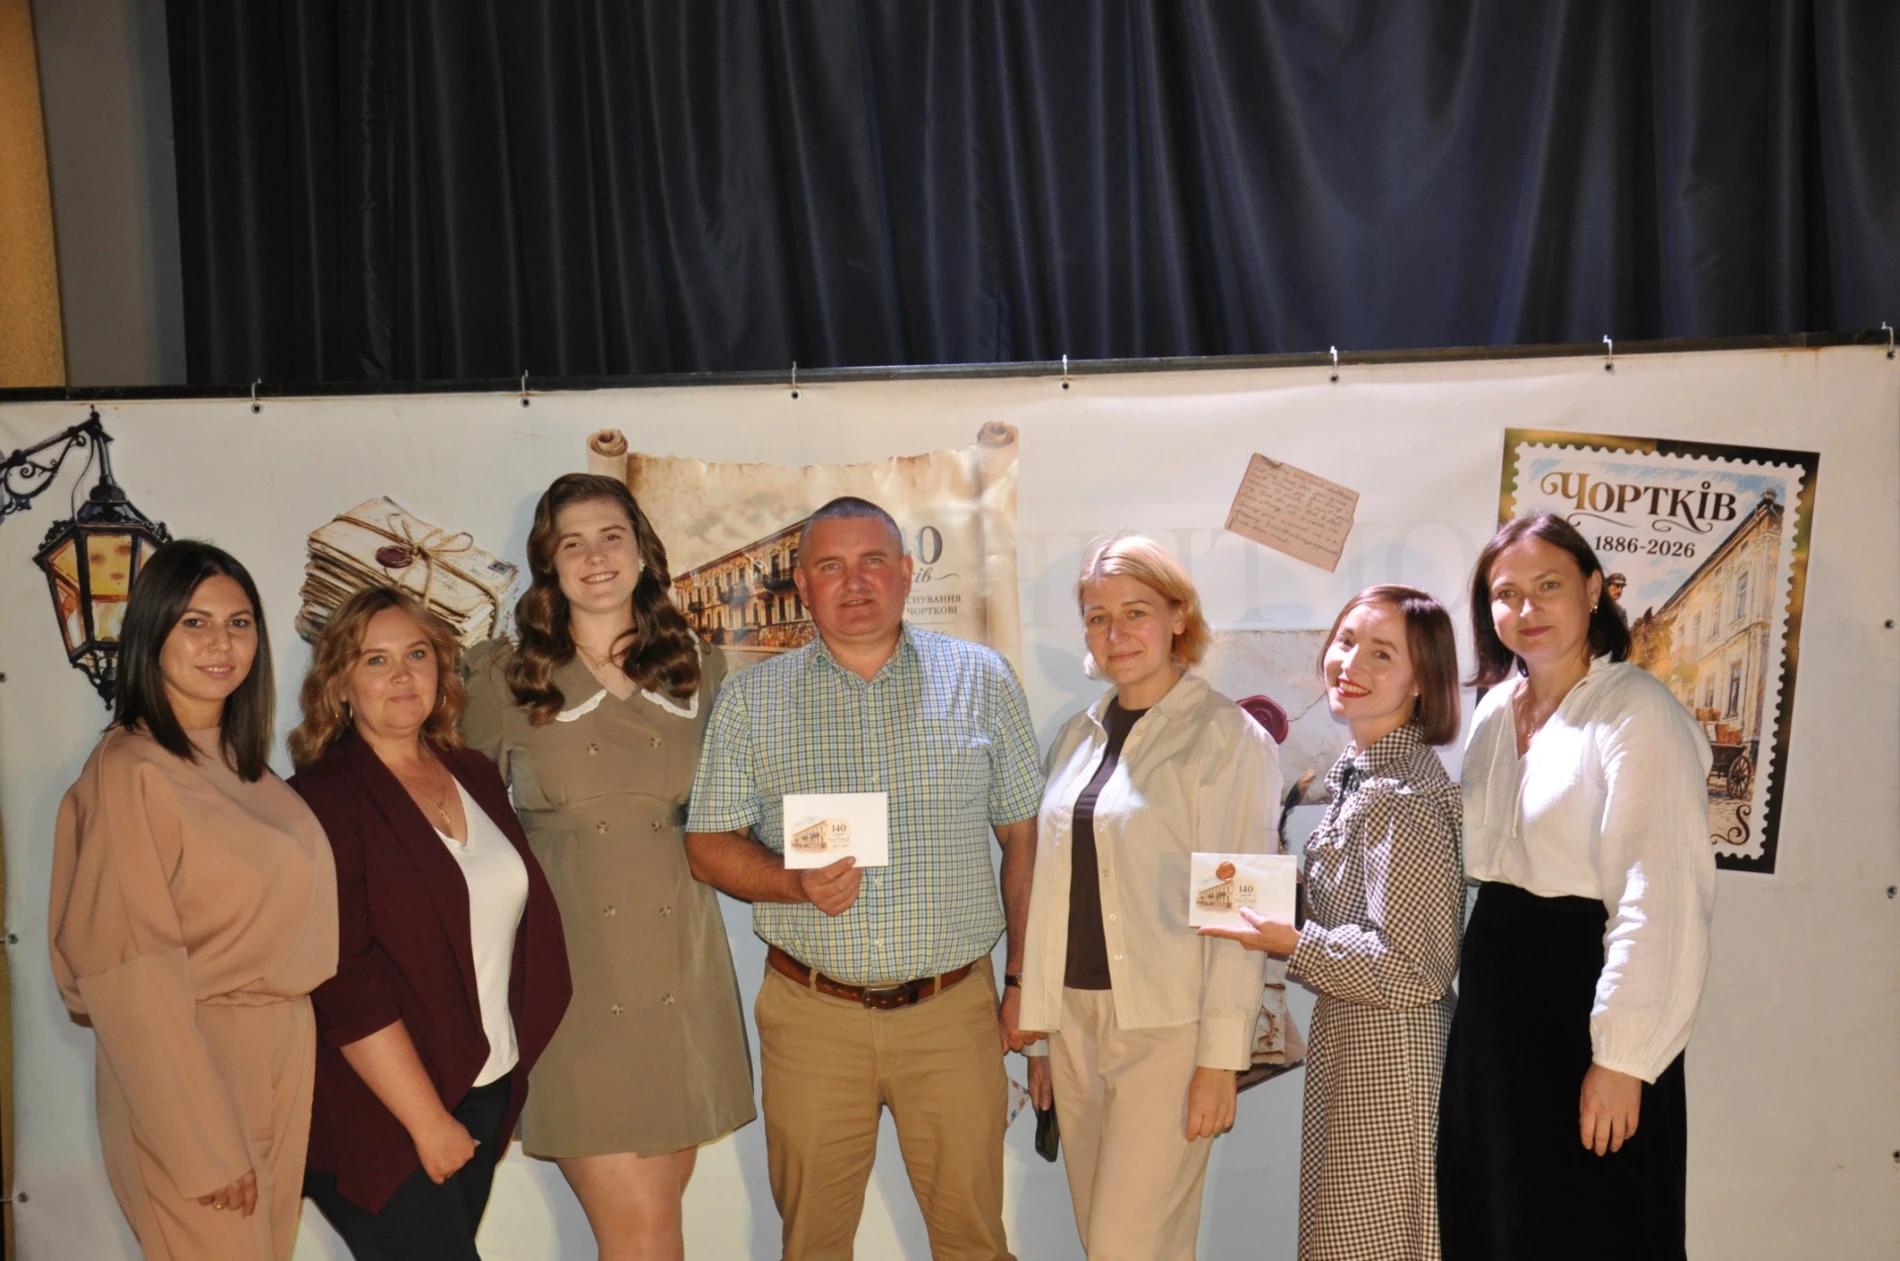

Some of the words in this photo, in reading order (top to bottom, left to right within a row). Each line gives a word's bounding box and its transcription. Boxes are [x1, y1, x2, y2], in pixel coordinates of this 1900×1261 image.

[1594, 535, 1696, 559] 1886-2026
[907, 606, 958, 616] ЧОРТКОВІ
[831, 824, 847, 833] 140
[1239, 885, 1254, 894] 140
